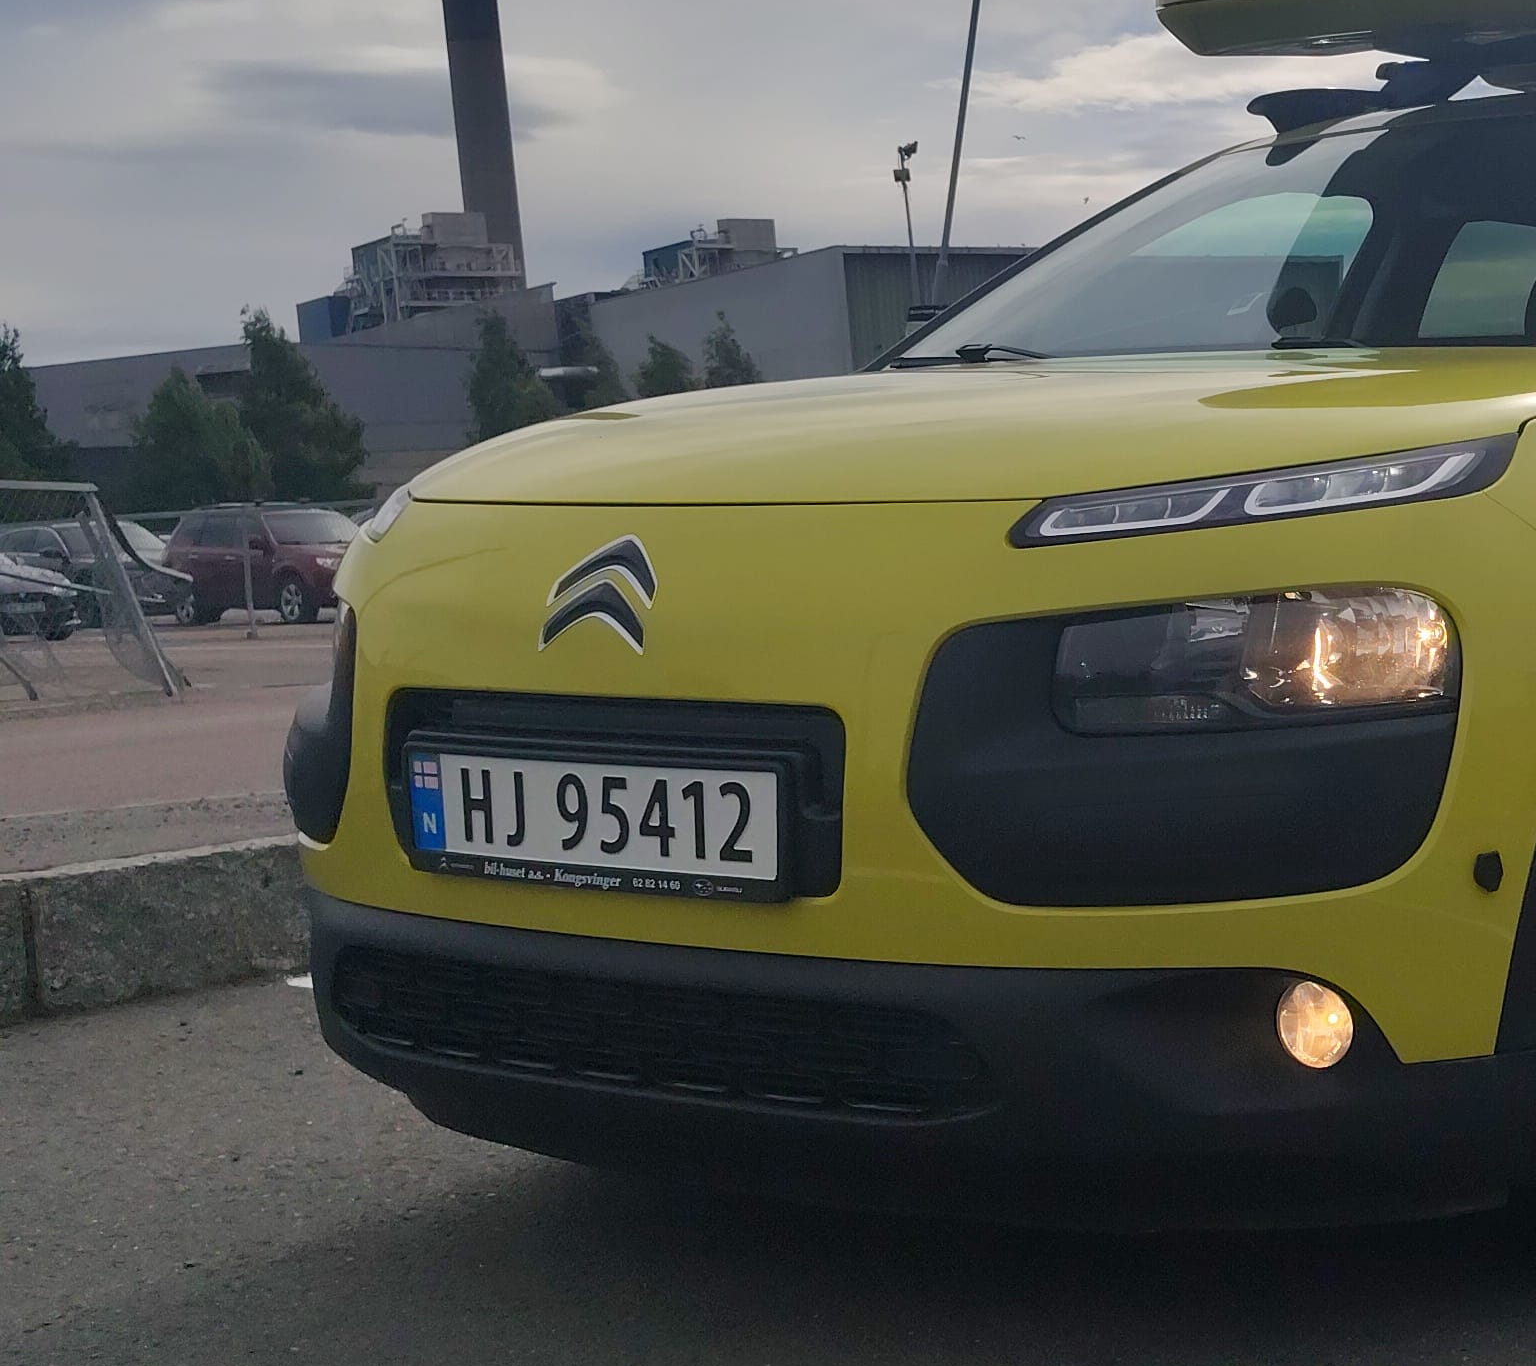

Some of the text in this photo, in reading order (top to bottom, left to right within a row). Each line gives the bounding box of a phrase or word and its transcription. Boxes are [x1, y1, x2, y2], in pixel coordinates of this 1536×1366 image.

[423, 812, 437, 835] N
[460, 767, 753, 863] HJ 95412
[553, 868, 622, 890] Kongsvinger
[658, 880, 668, 890] 14
